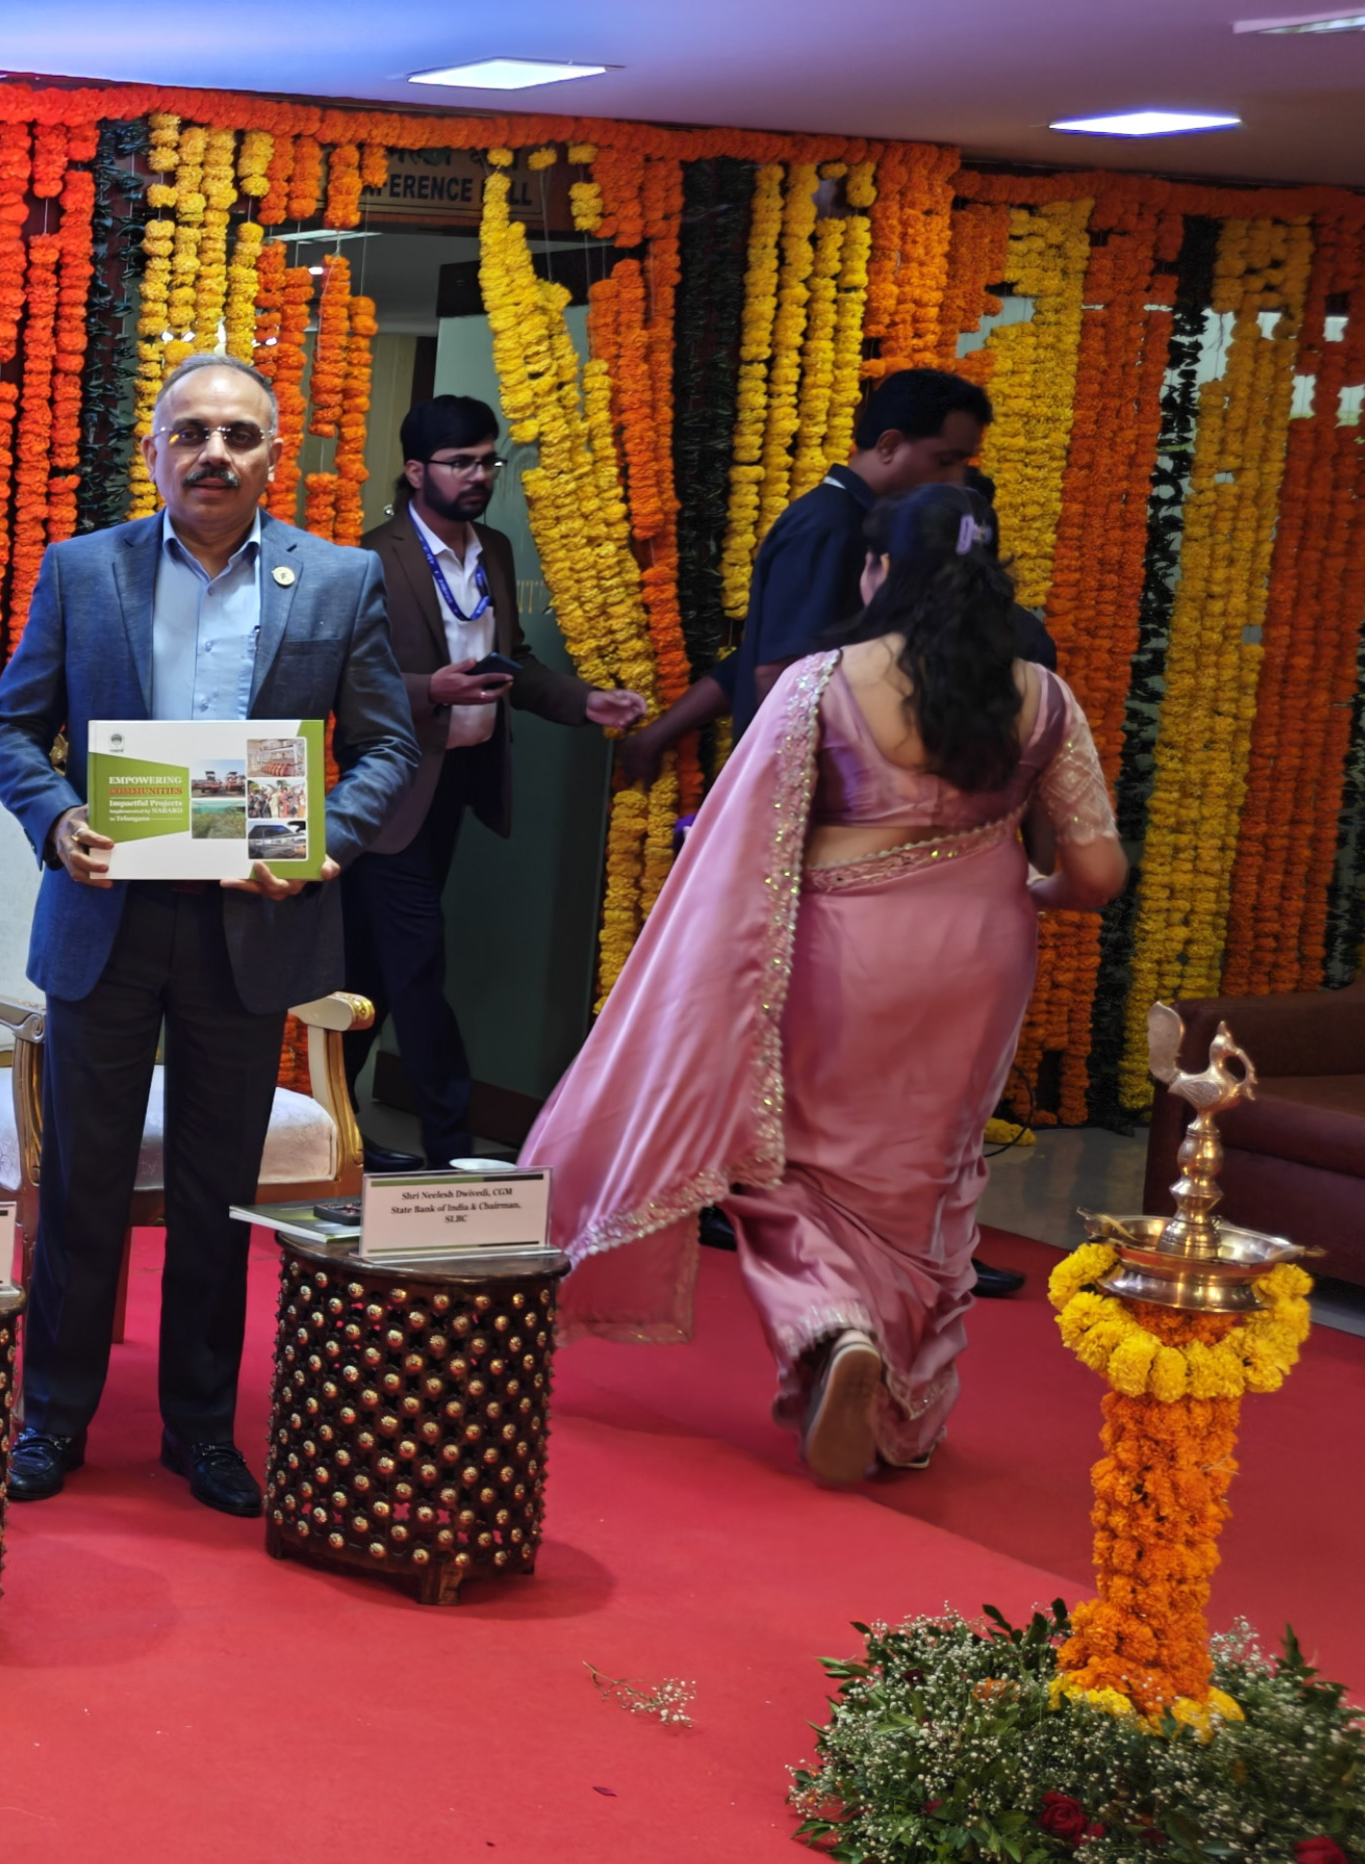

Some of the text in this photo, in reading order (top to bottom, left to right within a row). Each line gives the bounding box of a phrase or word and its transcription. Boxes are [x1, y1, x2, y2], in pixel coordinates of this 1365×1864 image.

[109, 776, 181, 784] EMPOWERING
[402, 1192, 419, 1200] Shri
[421, 1191, 453, 1199] Neelesh
[493, 1188, 512, 1196] CGM
[391, 1206, 412, 1214] State
[414, 1205, 435, 1213] Bank
[437, 1204, 447, 1212] of
[447, 1203, 468, 1211] India
